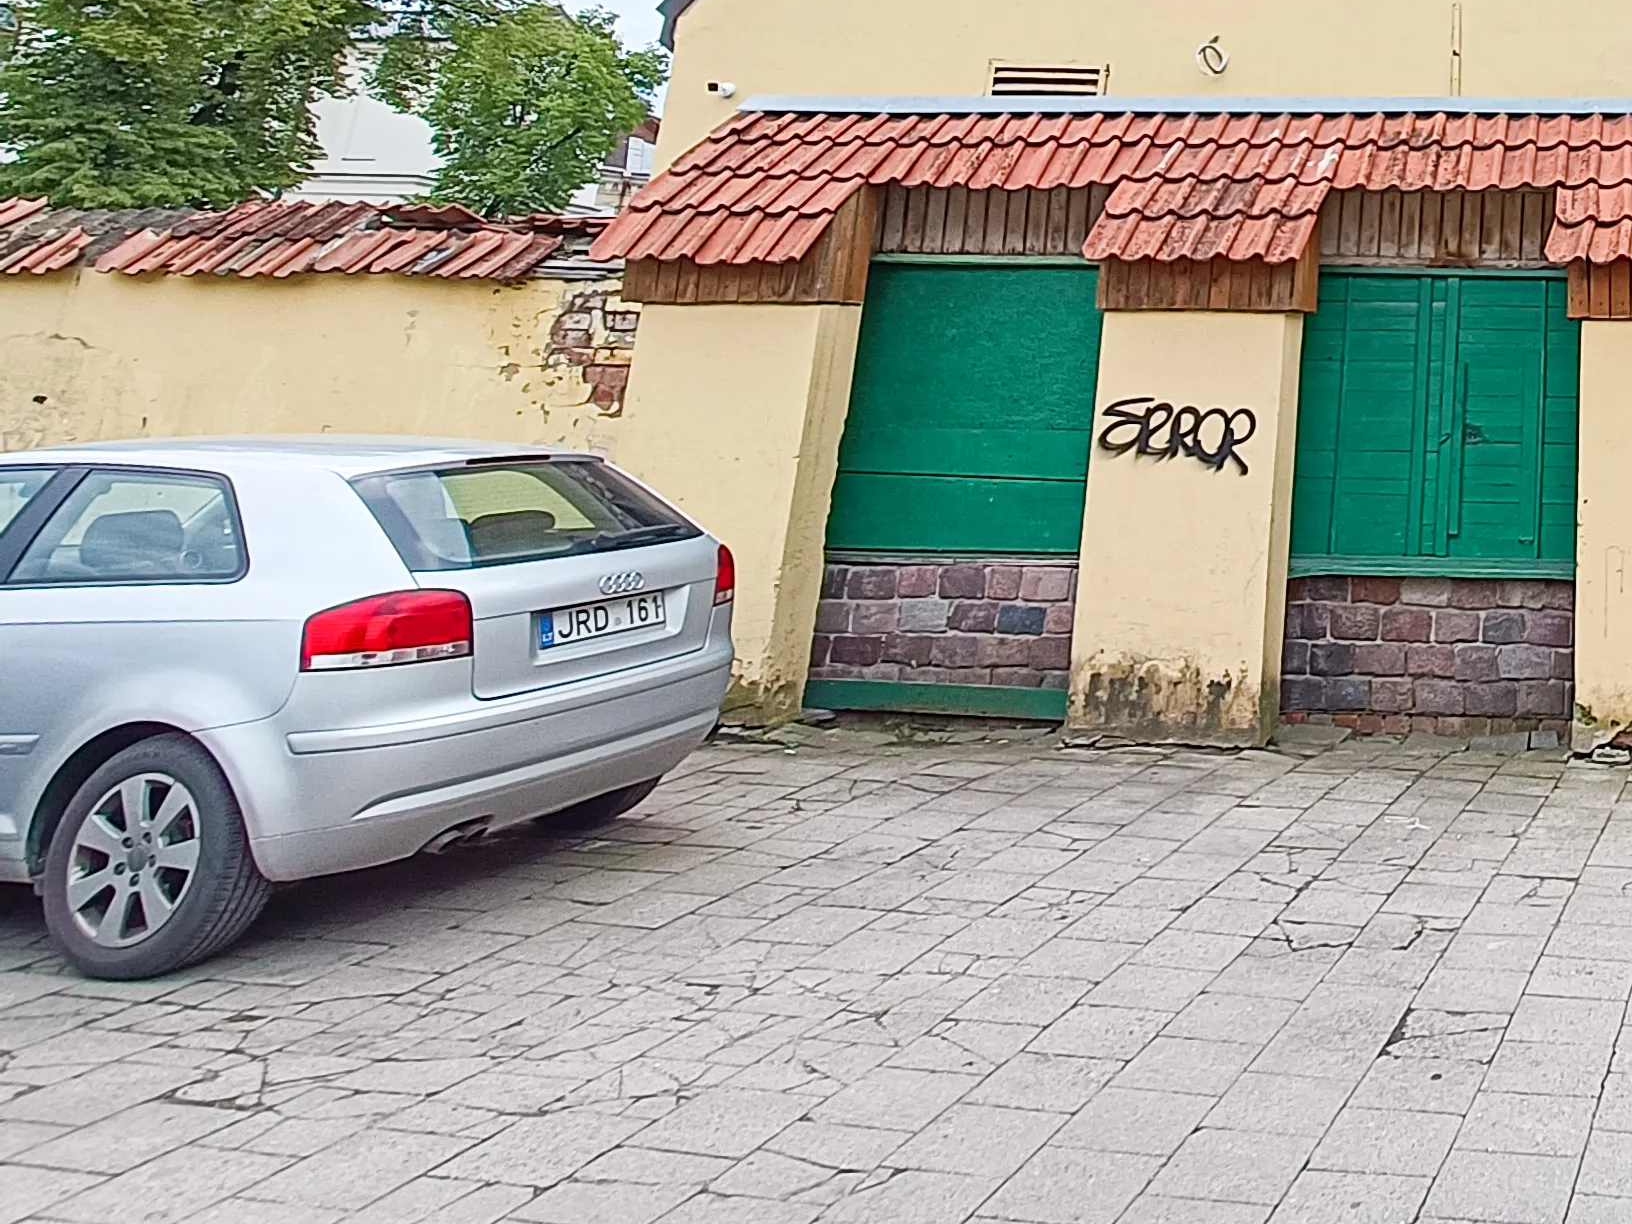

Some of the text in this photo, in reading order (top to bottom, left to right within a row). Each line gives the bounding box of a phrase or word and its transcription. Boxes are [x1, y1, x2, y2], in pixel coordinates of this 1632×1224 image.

[558, 594, 662, 639] JRD 161
[542, 633, 553, 642] LT
